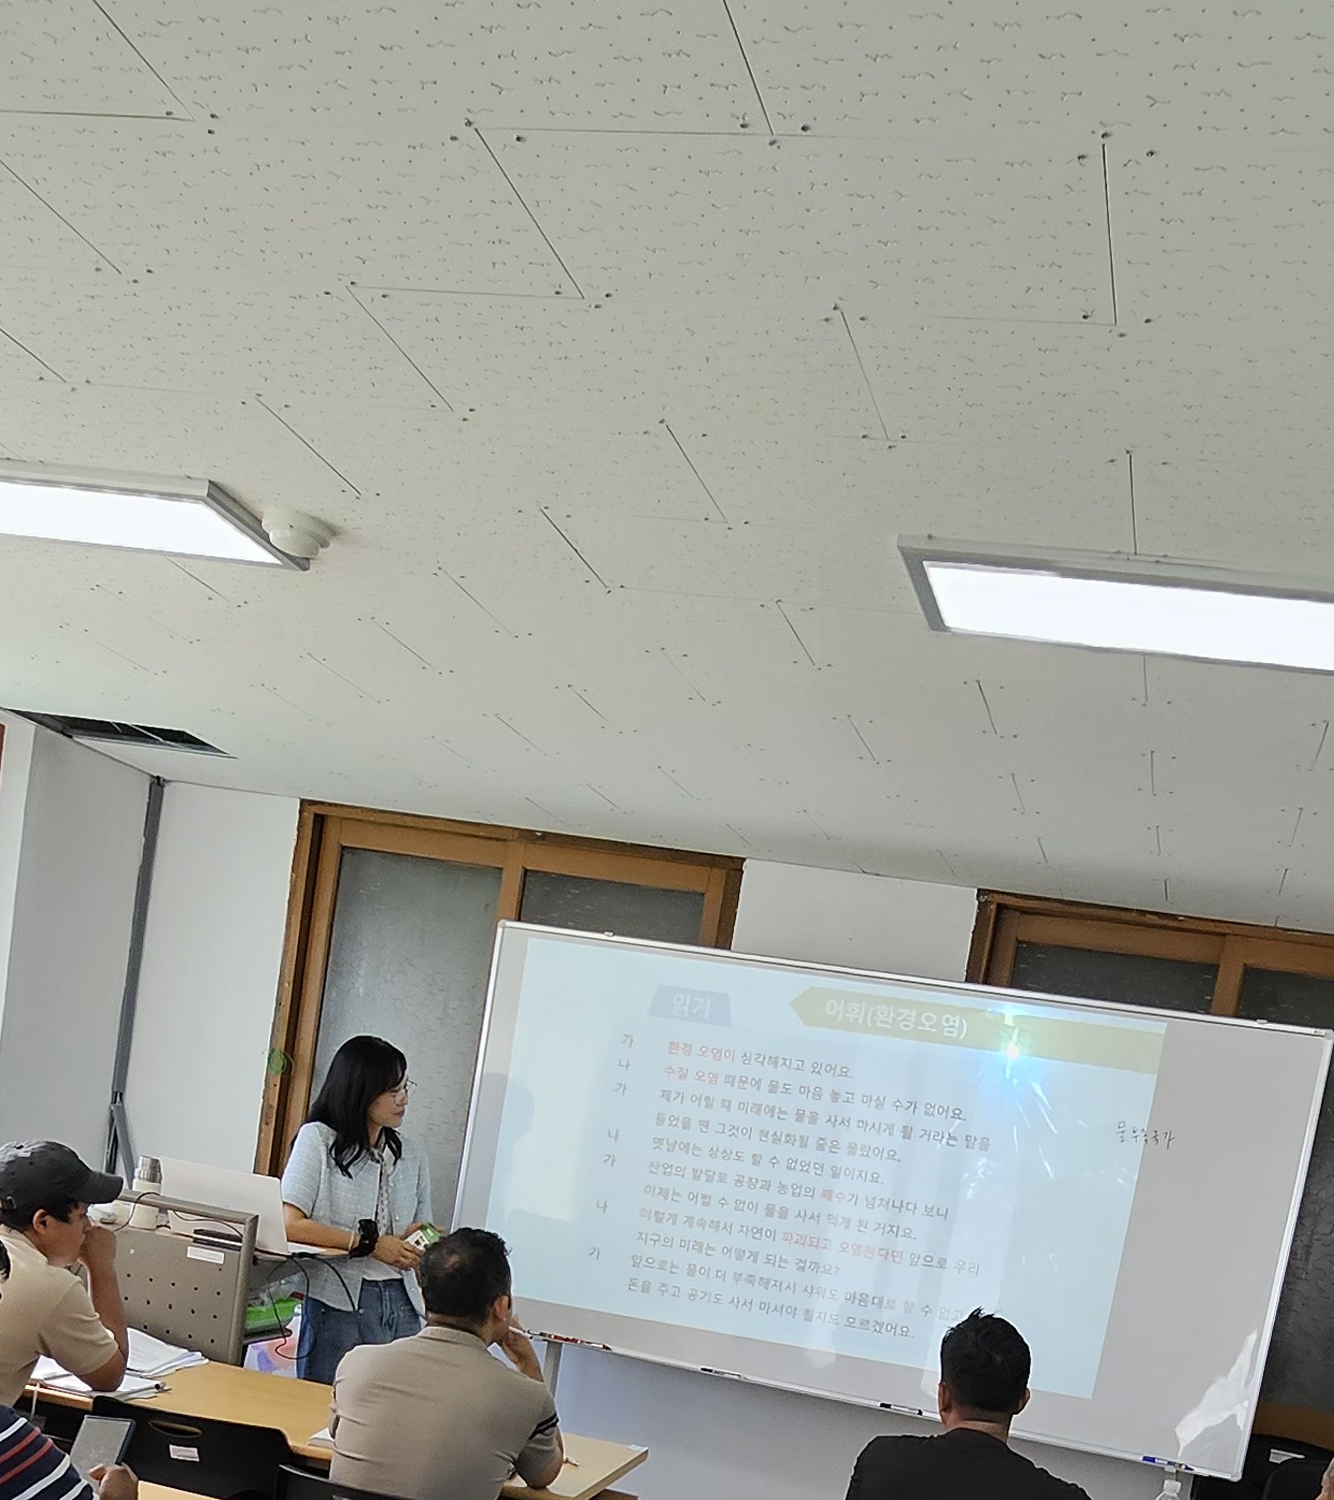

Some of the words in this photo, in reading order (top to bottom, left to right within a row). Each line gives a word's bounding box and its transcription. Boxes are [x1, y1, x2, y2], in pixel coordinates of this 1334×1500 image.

[672, 993, 711, 1019] 읽기
[826, 999, 968, 1040] 어휘(환경오염)
[810, 1060, 853, 1079] 있어요.
[724, 1074, 762, 1090] 때문에
[799, 1085, 823, 1101] 마음
[861, 1094, 886, 1110] 마실
[892, 1099, 917, 1115] 수가
[738, 1101, 788, 1121] 미래에는
[826, 1114, 851, 1129] 사서
[715, 1123, 753, 1139] 그것이
[708, 1146, 744, 1162] 상상도
[768, 1156, 780, 1168] 수
[717, 1197, 728, 1209] 수
[734, 1199, 758, 1214] 없이
[795, 1209, 821, 1224] 사서
[873, 1222, 917, 1240] 거지요.
[922, 1204, 949, 1220] 보니
[636, 1231, 674, 1249] 지구의
[679, 1239, 716, 1257] 미래는
[764, 1254, 789, 1268] 되는
[738, 1224, 776, 1241] 자연이
[909, 1252, 947, 1270] 앞으로
[954, 1259, 979, 1276] 우리
[687, 1288, 723, 1305] 공기도
[729, 1296, 754, 1312] 사서
[715, 1269, 726, 1282] 더
[845, 1291, 896, 1311] 마음대로
[921, 1305, 932, 1317] 수
